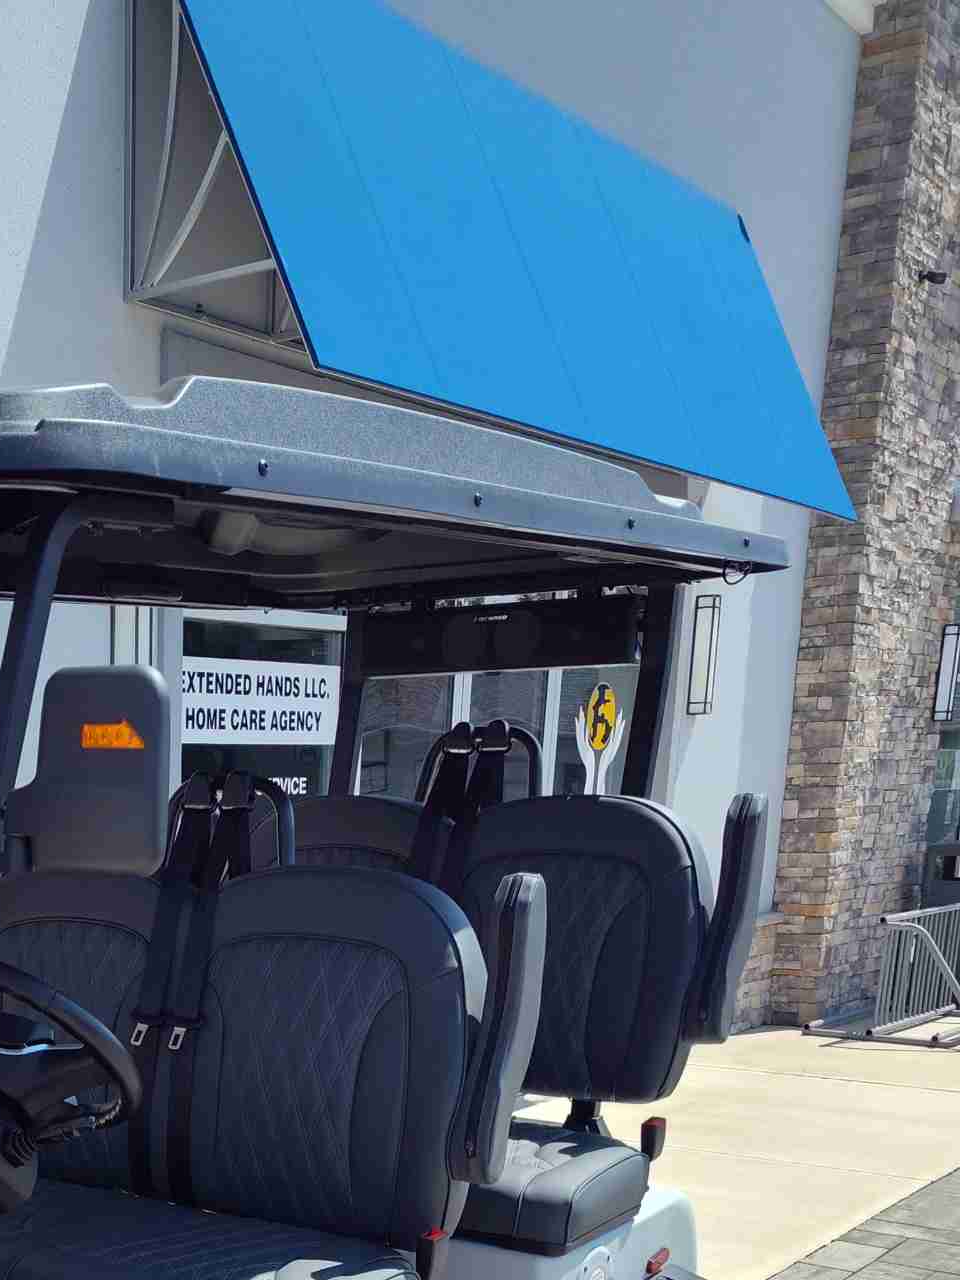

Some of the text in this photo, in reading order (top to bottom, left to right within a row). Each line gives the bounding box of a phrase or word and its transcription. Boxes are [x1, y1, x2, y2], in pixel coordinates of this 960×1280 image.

[256, 675, 300, 698] HANDS
[304, 677, 330, 699] LLC.
[185, 707, 322, 732] HOME CARE AGENCY
